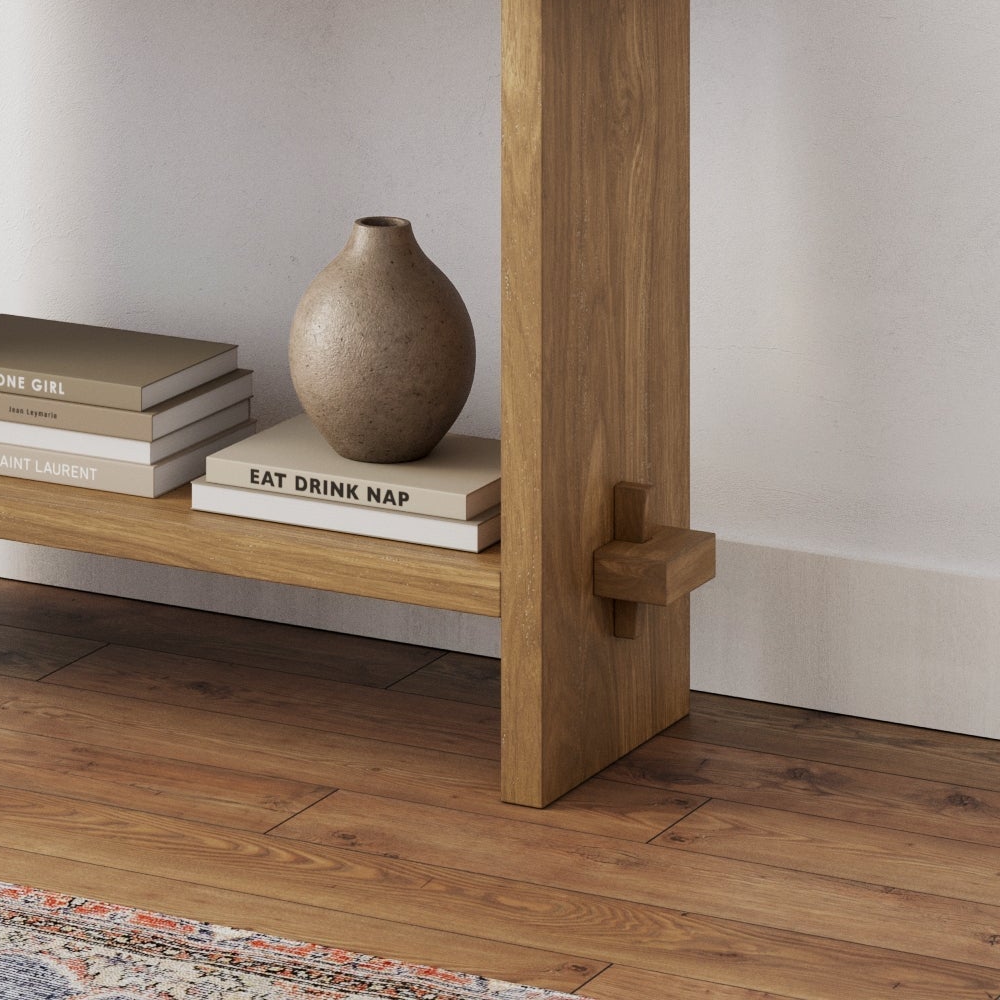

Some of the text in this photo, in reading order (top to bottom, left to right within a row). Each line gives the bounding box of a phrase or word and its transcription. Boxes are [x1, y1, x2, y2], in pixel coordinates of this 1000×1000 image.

[31, 378, 65, 395] GIRL
[8, 405, 24, 415] Jean
[35, 459, 97, 481] LAURENT
[250, 468, 410, 507] EAT DRINK NAP
